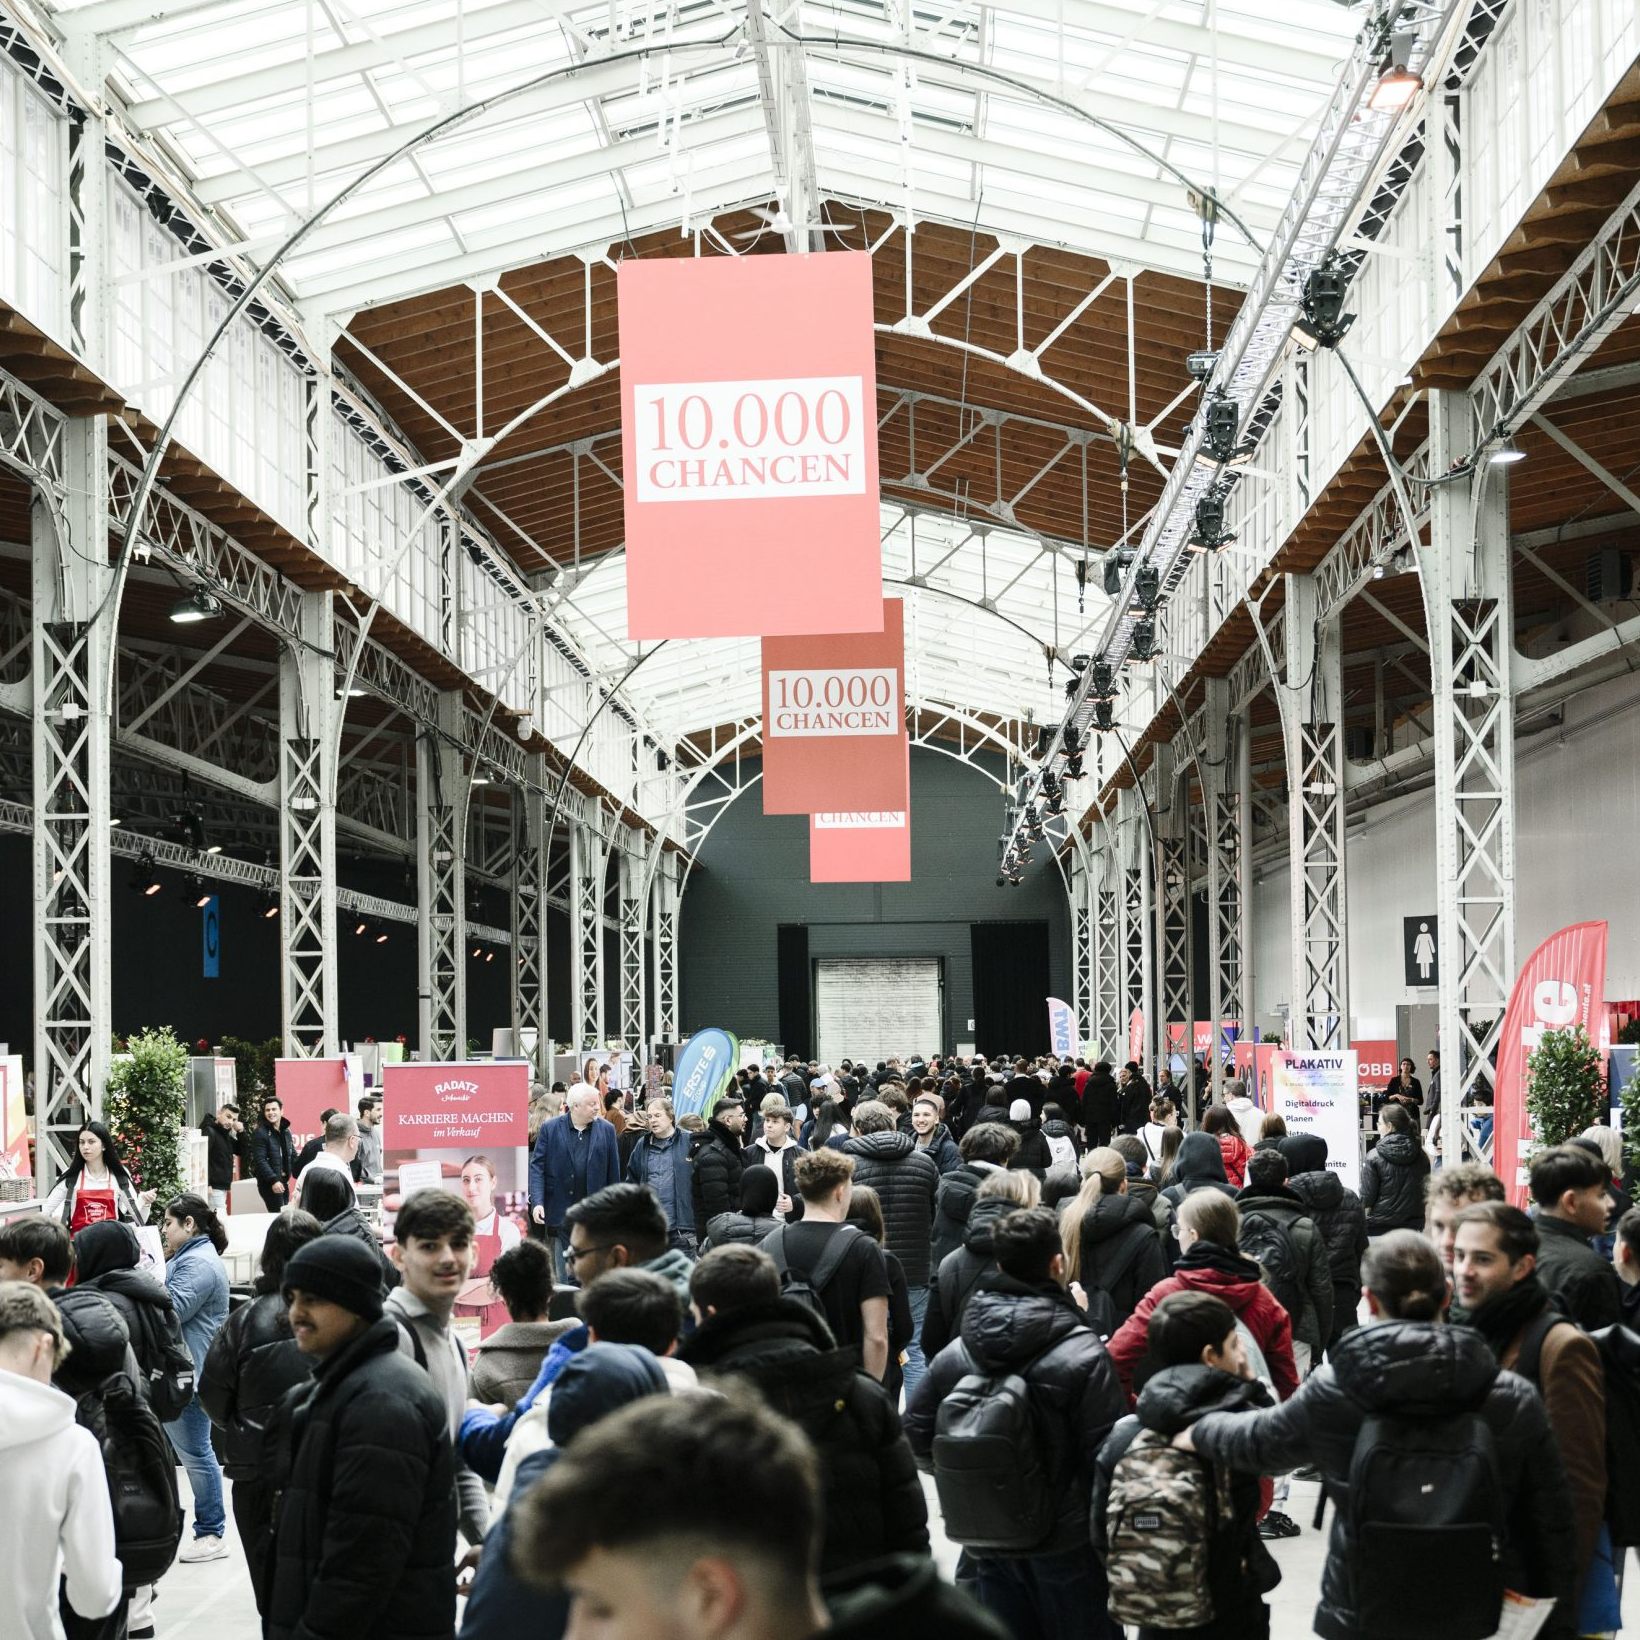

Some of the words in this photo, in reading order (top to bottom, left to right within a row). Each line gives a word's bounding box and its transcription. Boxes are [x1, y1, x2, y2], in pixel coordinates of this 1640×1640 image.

[649, 389, 850, 450] 10.000
[649, 453, 851, 489] CHANCEN
[777, 675, 890, 708] 10.000
[776, 711, 890, 730] CHANCEN
[1285, 1058, 1343, 1069] PLAKATIV
[683, 1058, 709, 1098] ERSTE
[434, 1080, 479, 1095] RADATZ
[1285, 1099, 1335, 1108] Digitaldruck
[399, 1113, 458, 1125] KARRIERE
[461, 1112, 514, 1123] MACHEN
[433, 1127, 445, 1137] im
[446, 1126, 481, 1138] Verkauf
